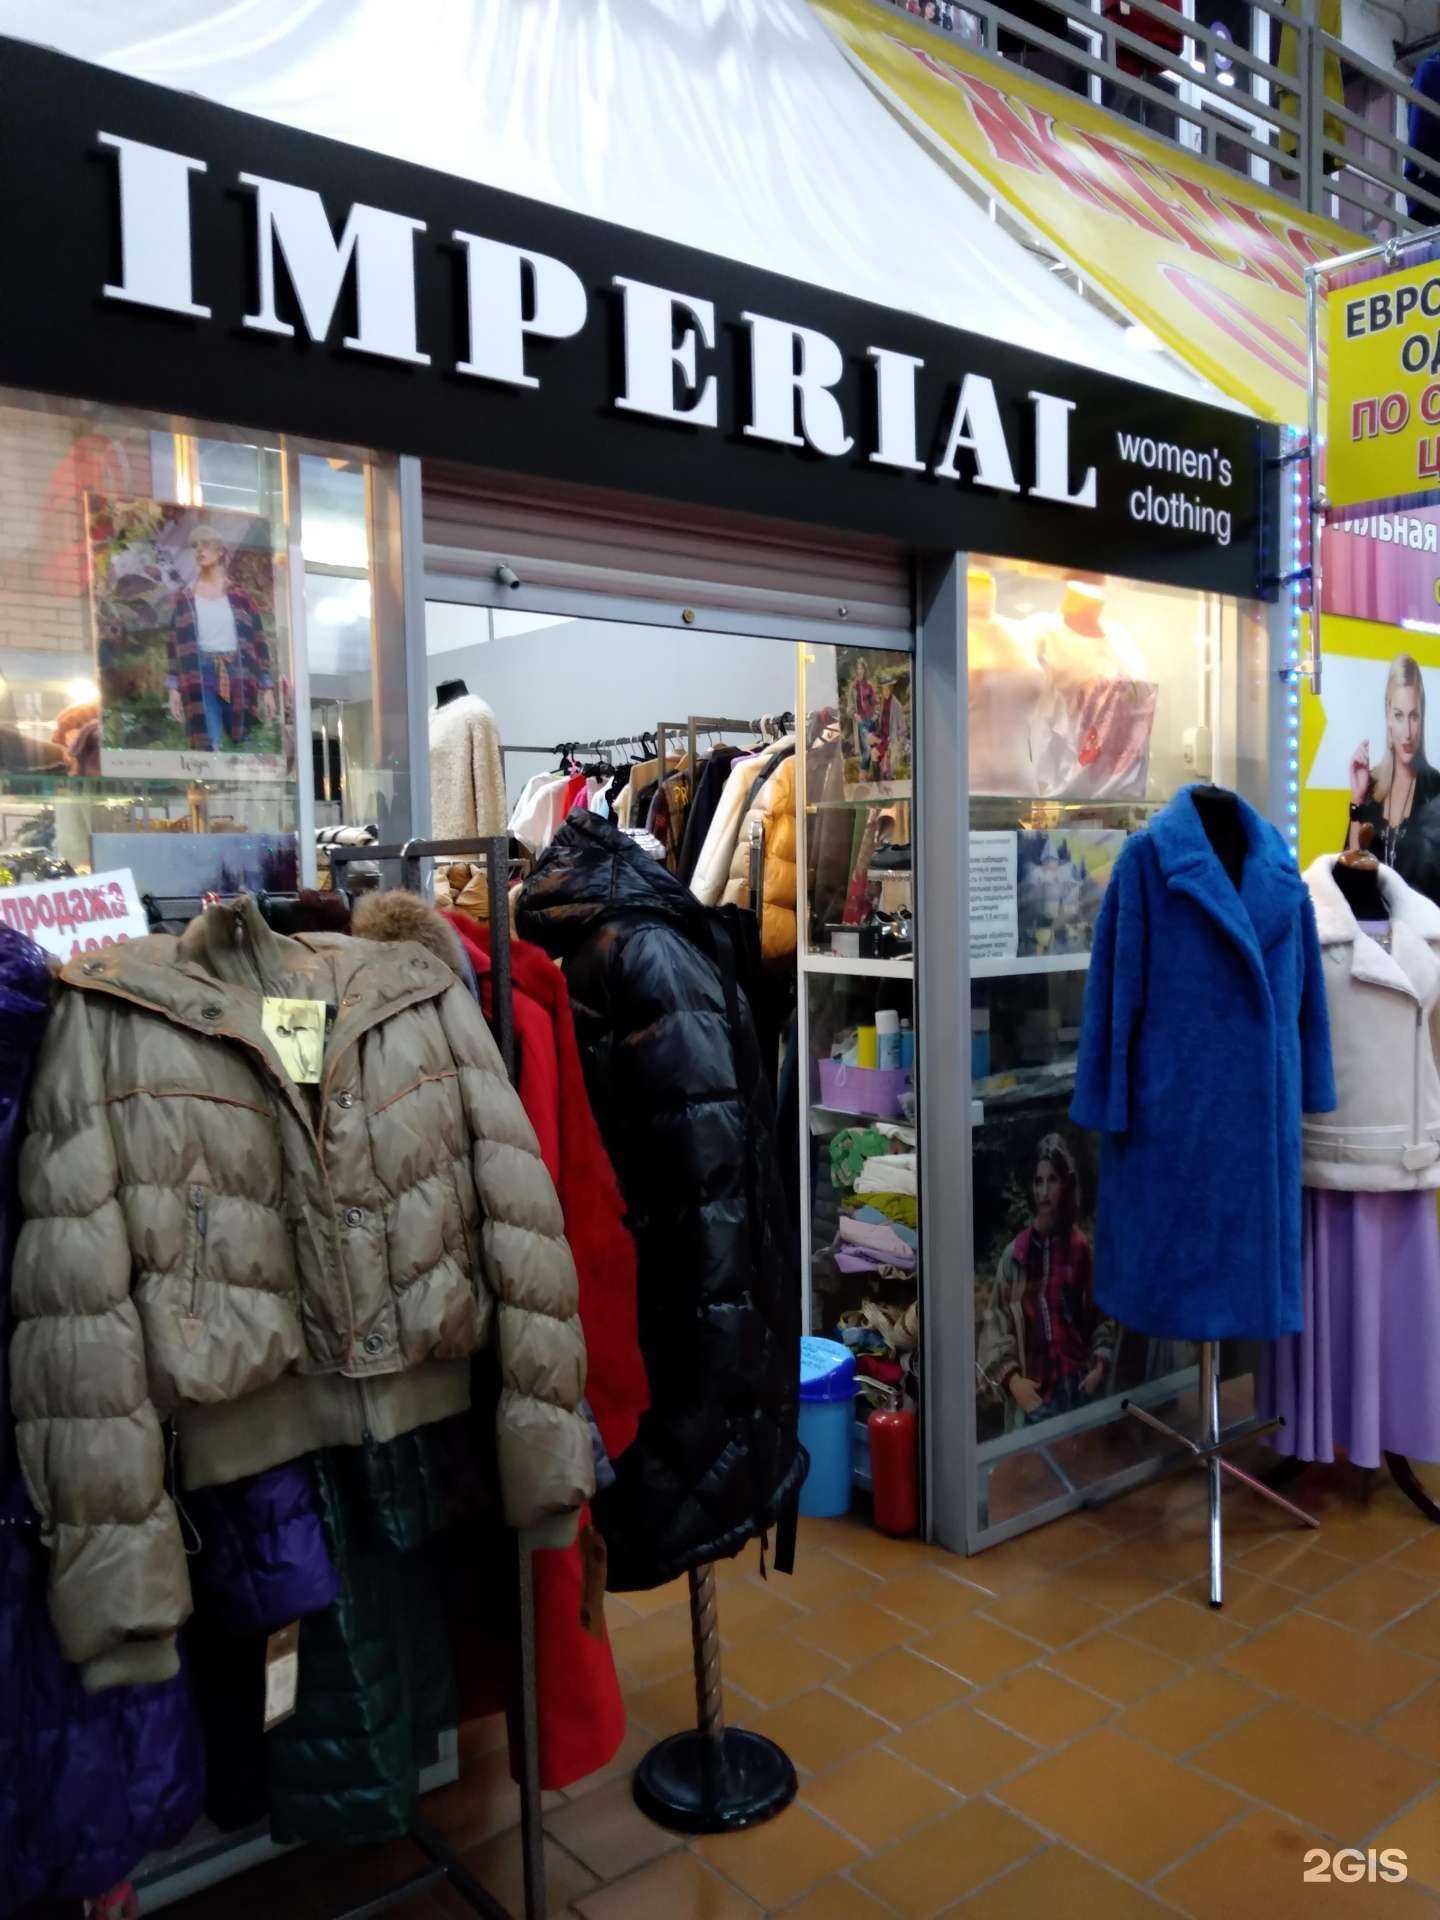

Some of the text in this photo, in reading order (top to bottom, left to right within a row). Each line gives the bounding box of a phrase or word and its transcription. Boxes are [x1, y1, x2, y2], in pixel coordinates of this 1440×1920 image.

[97, 131, 1097, 508] IMPERIAL
[1401, 327, 1440, 376] О
[1352, 392, 1410, 443] ПО
[1117, 431, 1232, 487] women's
[1130, 485, 1231, 545] clothing
[0, 881, 130, 940] продажа
